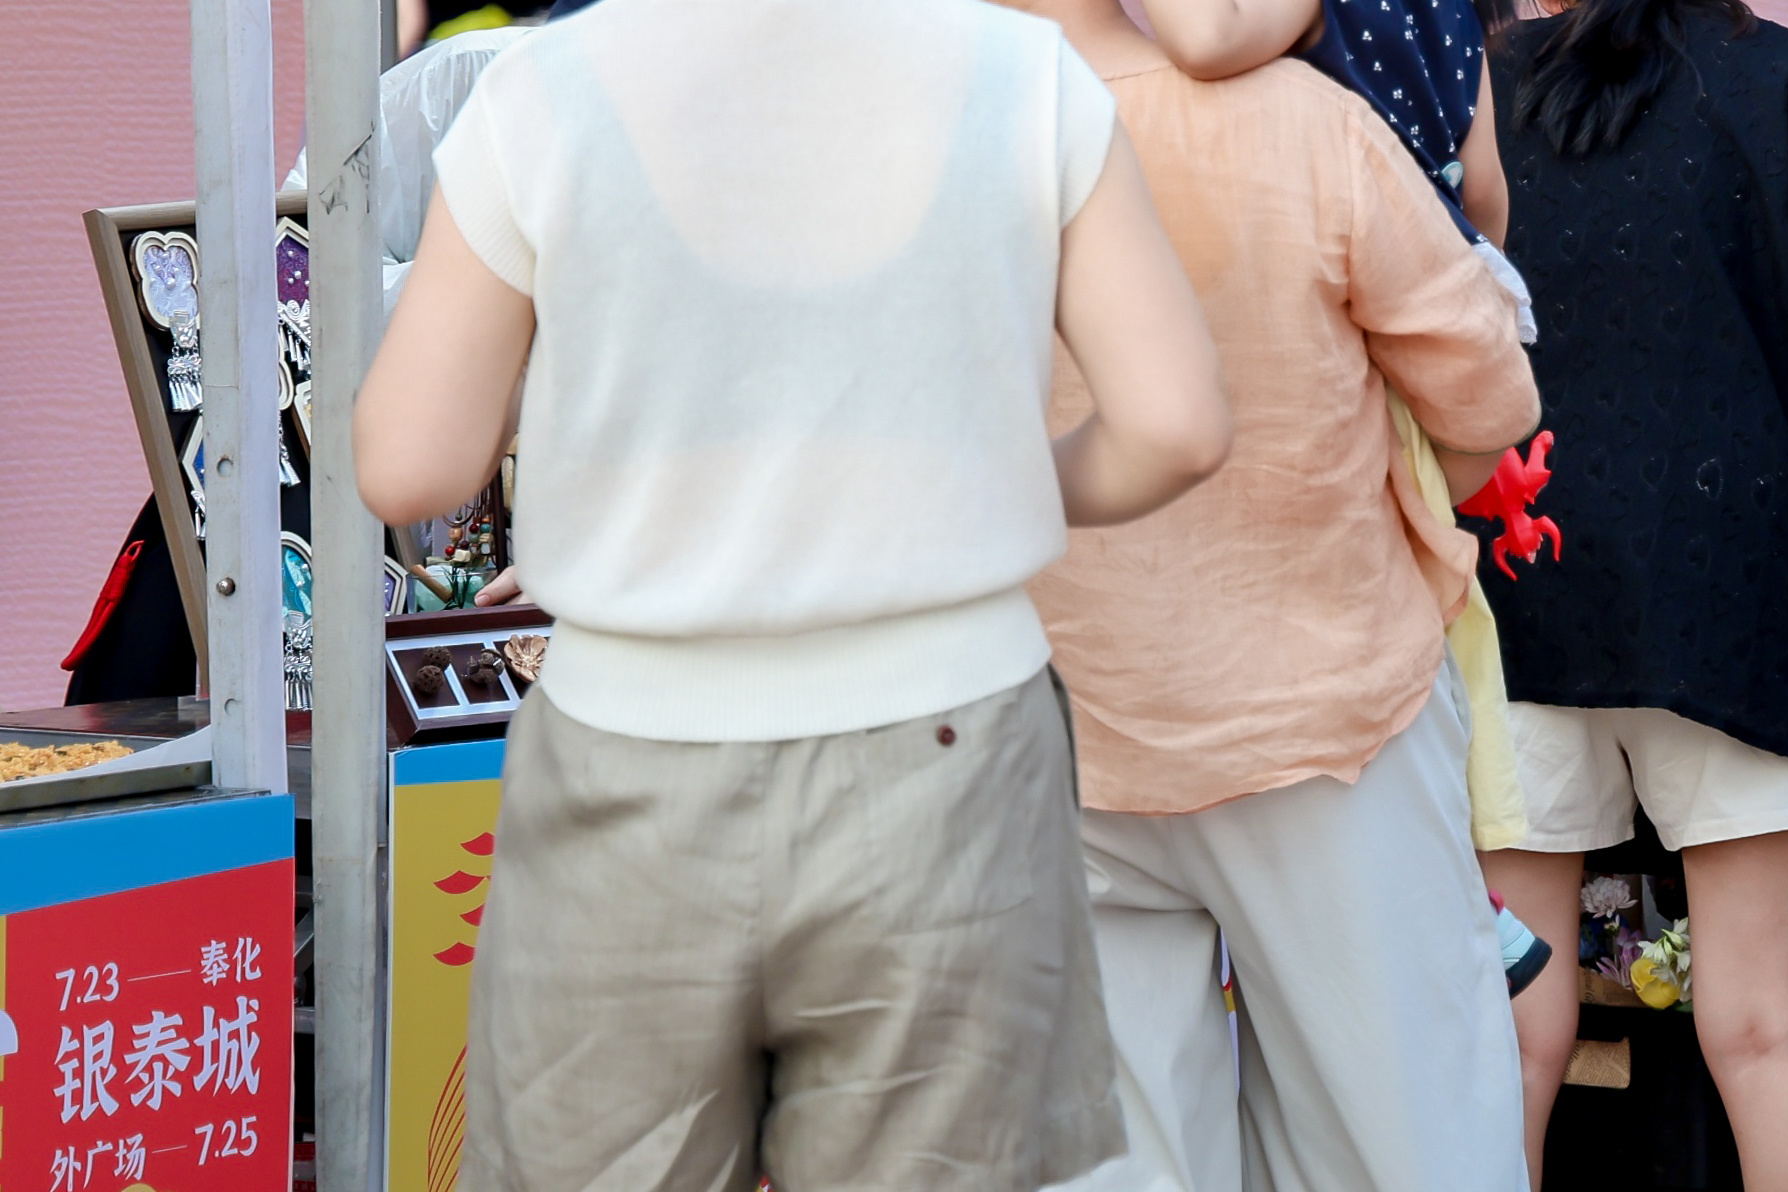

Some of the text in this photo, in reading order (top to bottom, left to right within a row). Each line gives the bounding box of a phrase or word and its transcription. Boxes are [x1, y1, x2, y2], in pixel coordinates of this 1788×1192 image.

[55, 937, 262, 1011] 7.23 奉化
[53, 995, 261, 1124] 银泰城
[49, 1115, 258, 1192] 外广场 7.25
